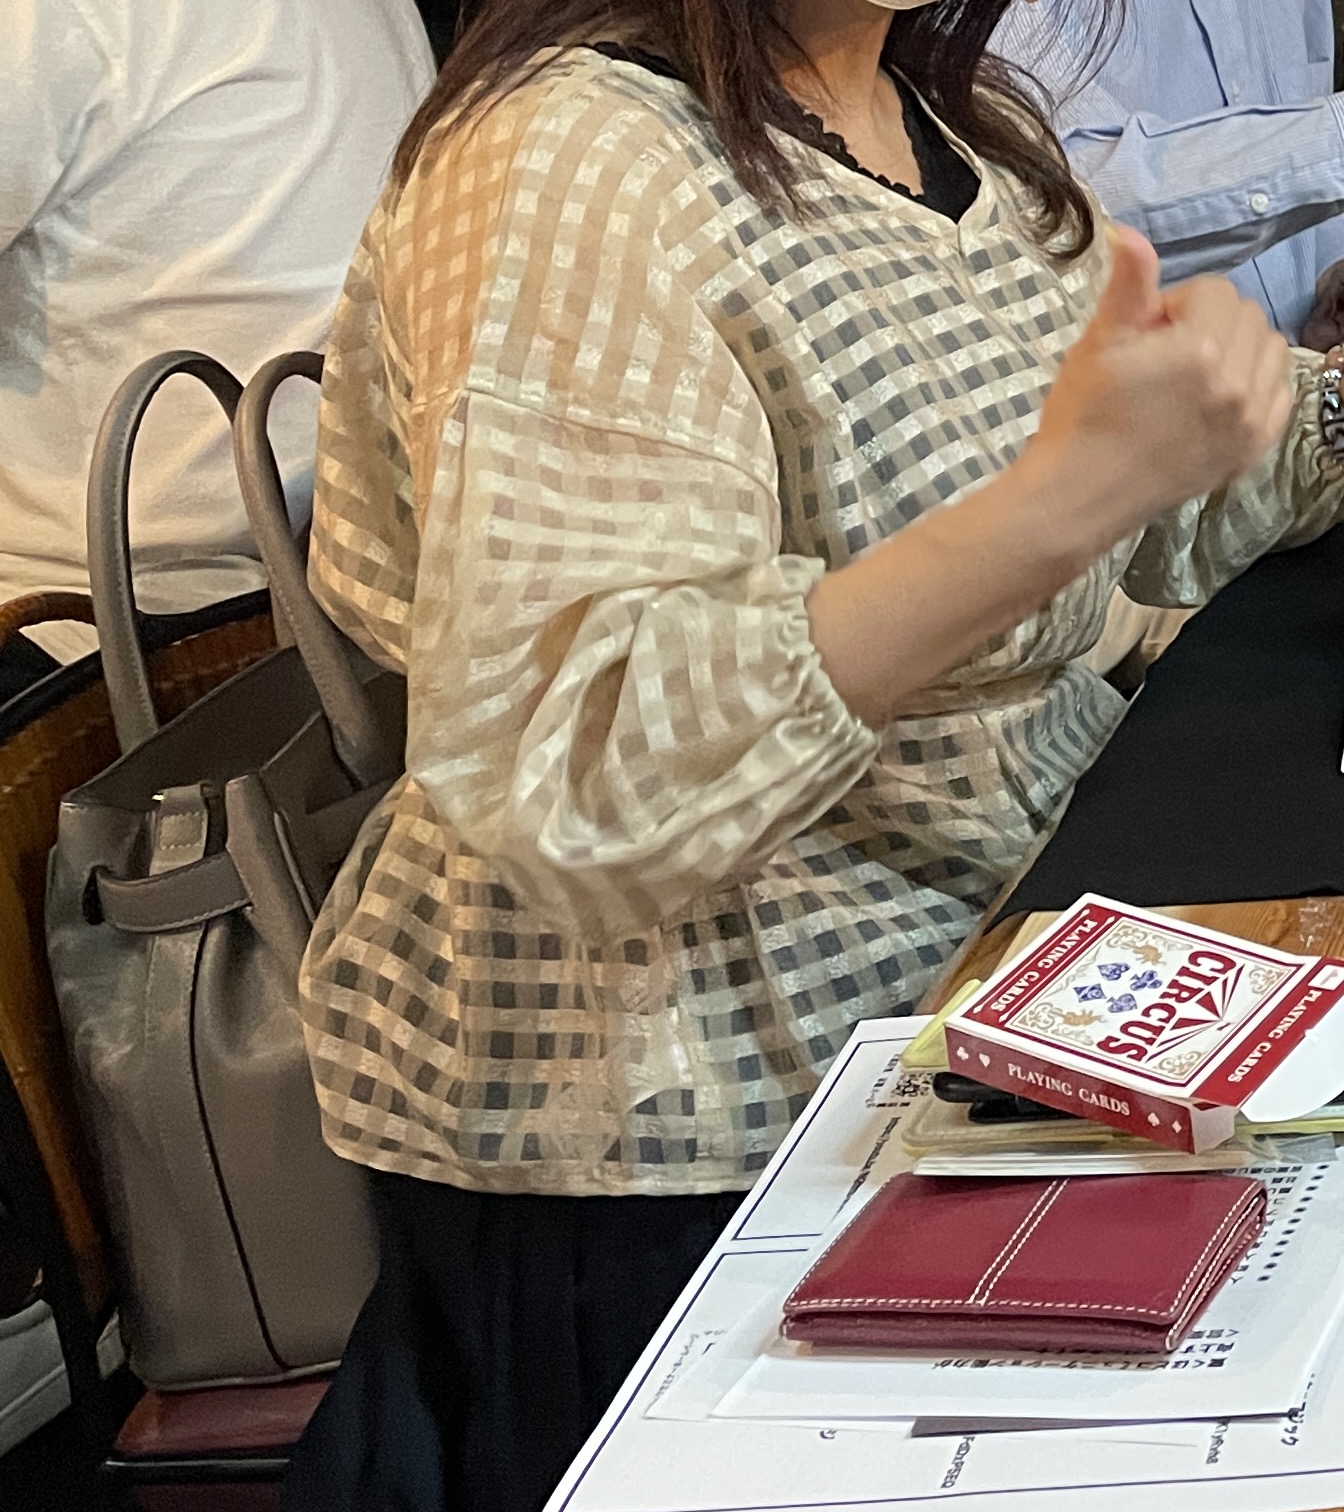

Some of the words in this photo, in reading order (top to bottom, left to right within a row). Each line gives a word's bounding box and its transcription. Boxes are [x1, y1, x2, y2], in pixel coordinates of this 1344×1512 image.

[1038, 918, 1098, 970] PLAYING
[994, 970, 1040, 1013] CARDS
[1094, 949, 1238, 1064] CIRCUS
[1268, 989, 1323, 1040] PLAYING
[1227, 1040, 1271, 1084] CARDS
[1007, 1063, 1073, 1097] PLAYING
[1078, 1087, 1131, 1117] CARDS
